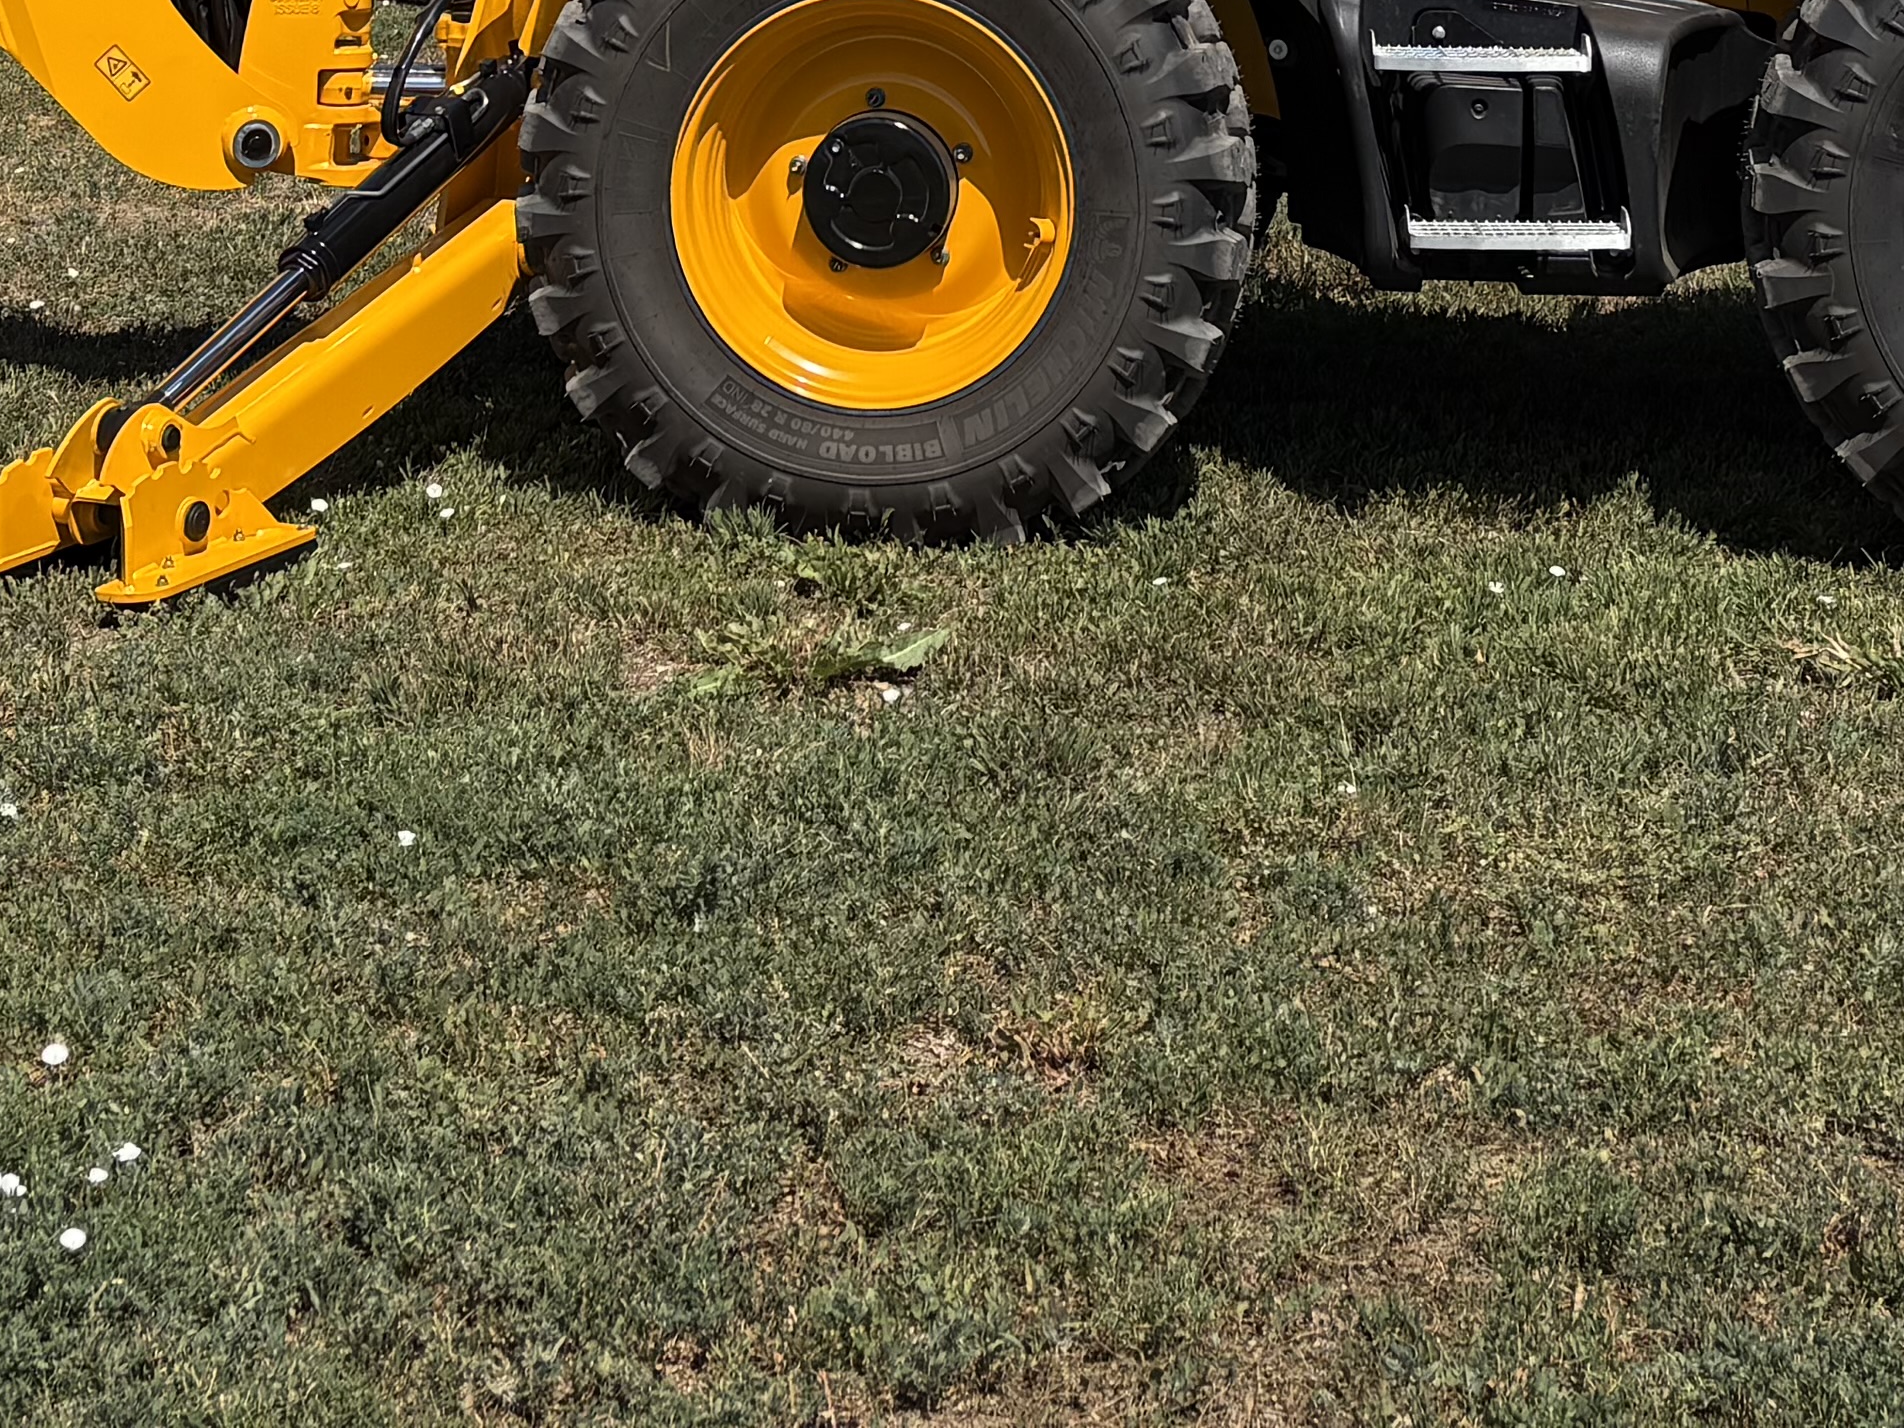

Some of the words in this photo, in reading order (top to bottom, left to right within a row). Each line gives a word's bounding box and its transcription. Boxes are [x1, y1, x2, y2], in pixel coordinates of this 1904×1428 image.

[963, 266, 1115, 449] MICHELIN
[709, 393, 768, 435] SURFACE
[751, 398, 774, 418] 28
[773, 410, 789, 425] R
[767, 427, 808, 451] HARD
[790, 416, 855, 441] 440/80
[817, 439, 942, 464] BIBLOAD
